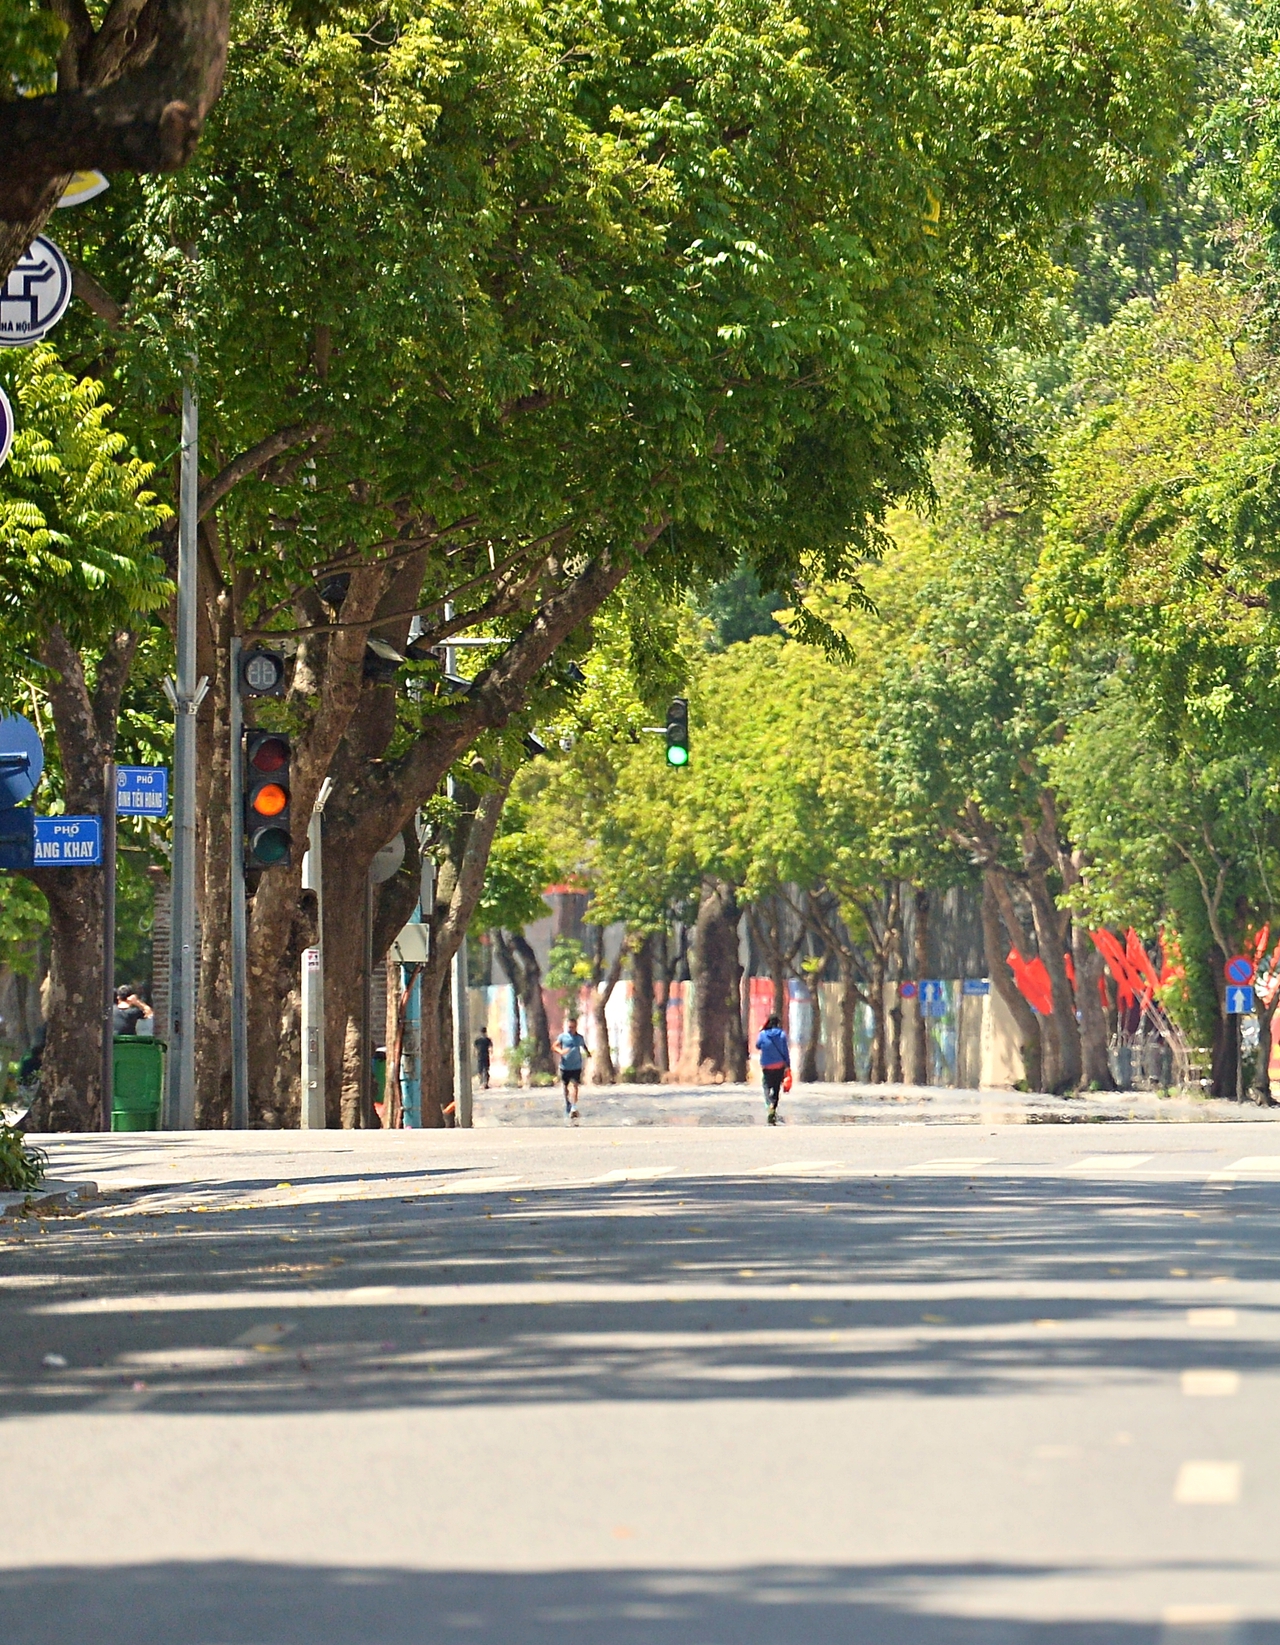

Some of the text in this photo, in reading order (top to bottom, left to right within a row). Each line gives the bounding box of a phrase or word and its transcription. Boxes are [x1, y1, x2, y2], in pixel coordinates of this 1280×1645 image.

[136, 772, 153, 784] PHỐ
[54, 822, 80, 835] PHỐ
[34, 839, 94, 858] ÀNG KHAY
